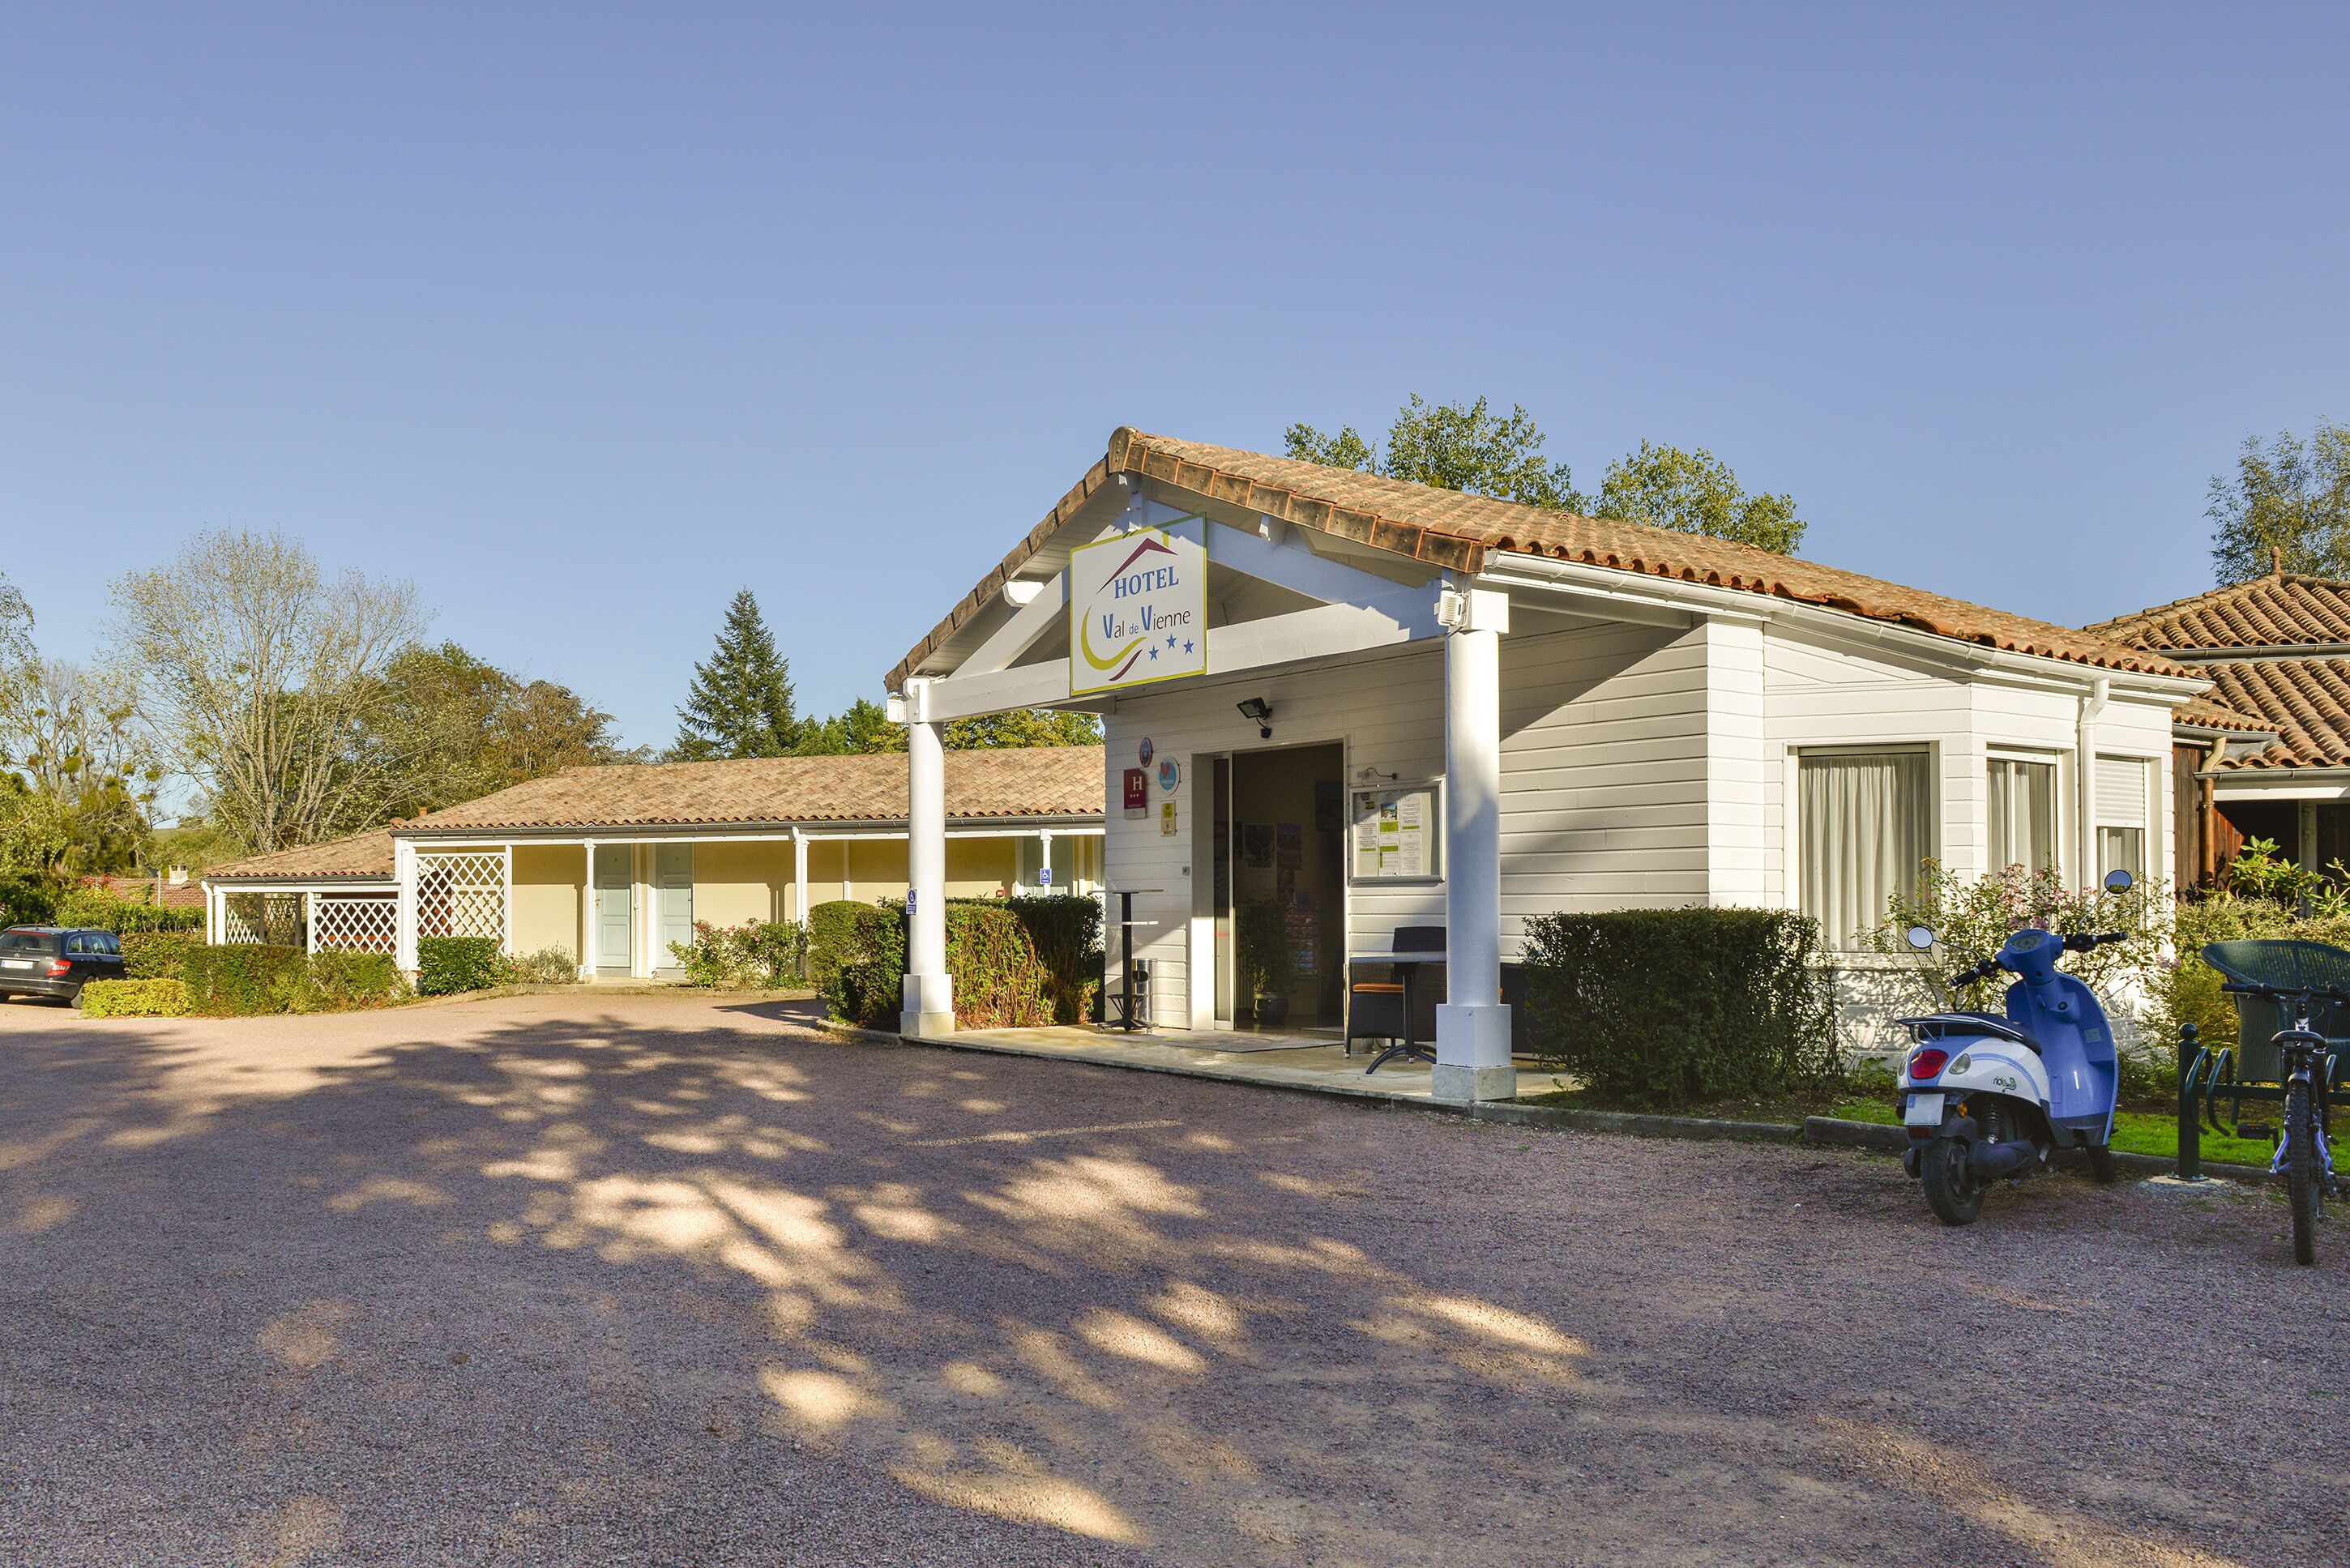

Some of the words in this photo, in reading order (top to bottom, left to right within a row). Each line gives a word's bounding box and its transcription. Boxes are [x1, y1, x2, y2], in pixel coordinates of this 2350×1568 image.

[1114, 566, 1179, 599] HOTEL
[1103, 613, 1125, 639] Val
[1129, 623, 1139, 635] de
[1141, 605, 1190, 630] Vienne
[1132, 775, 1143, 791] H
